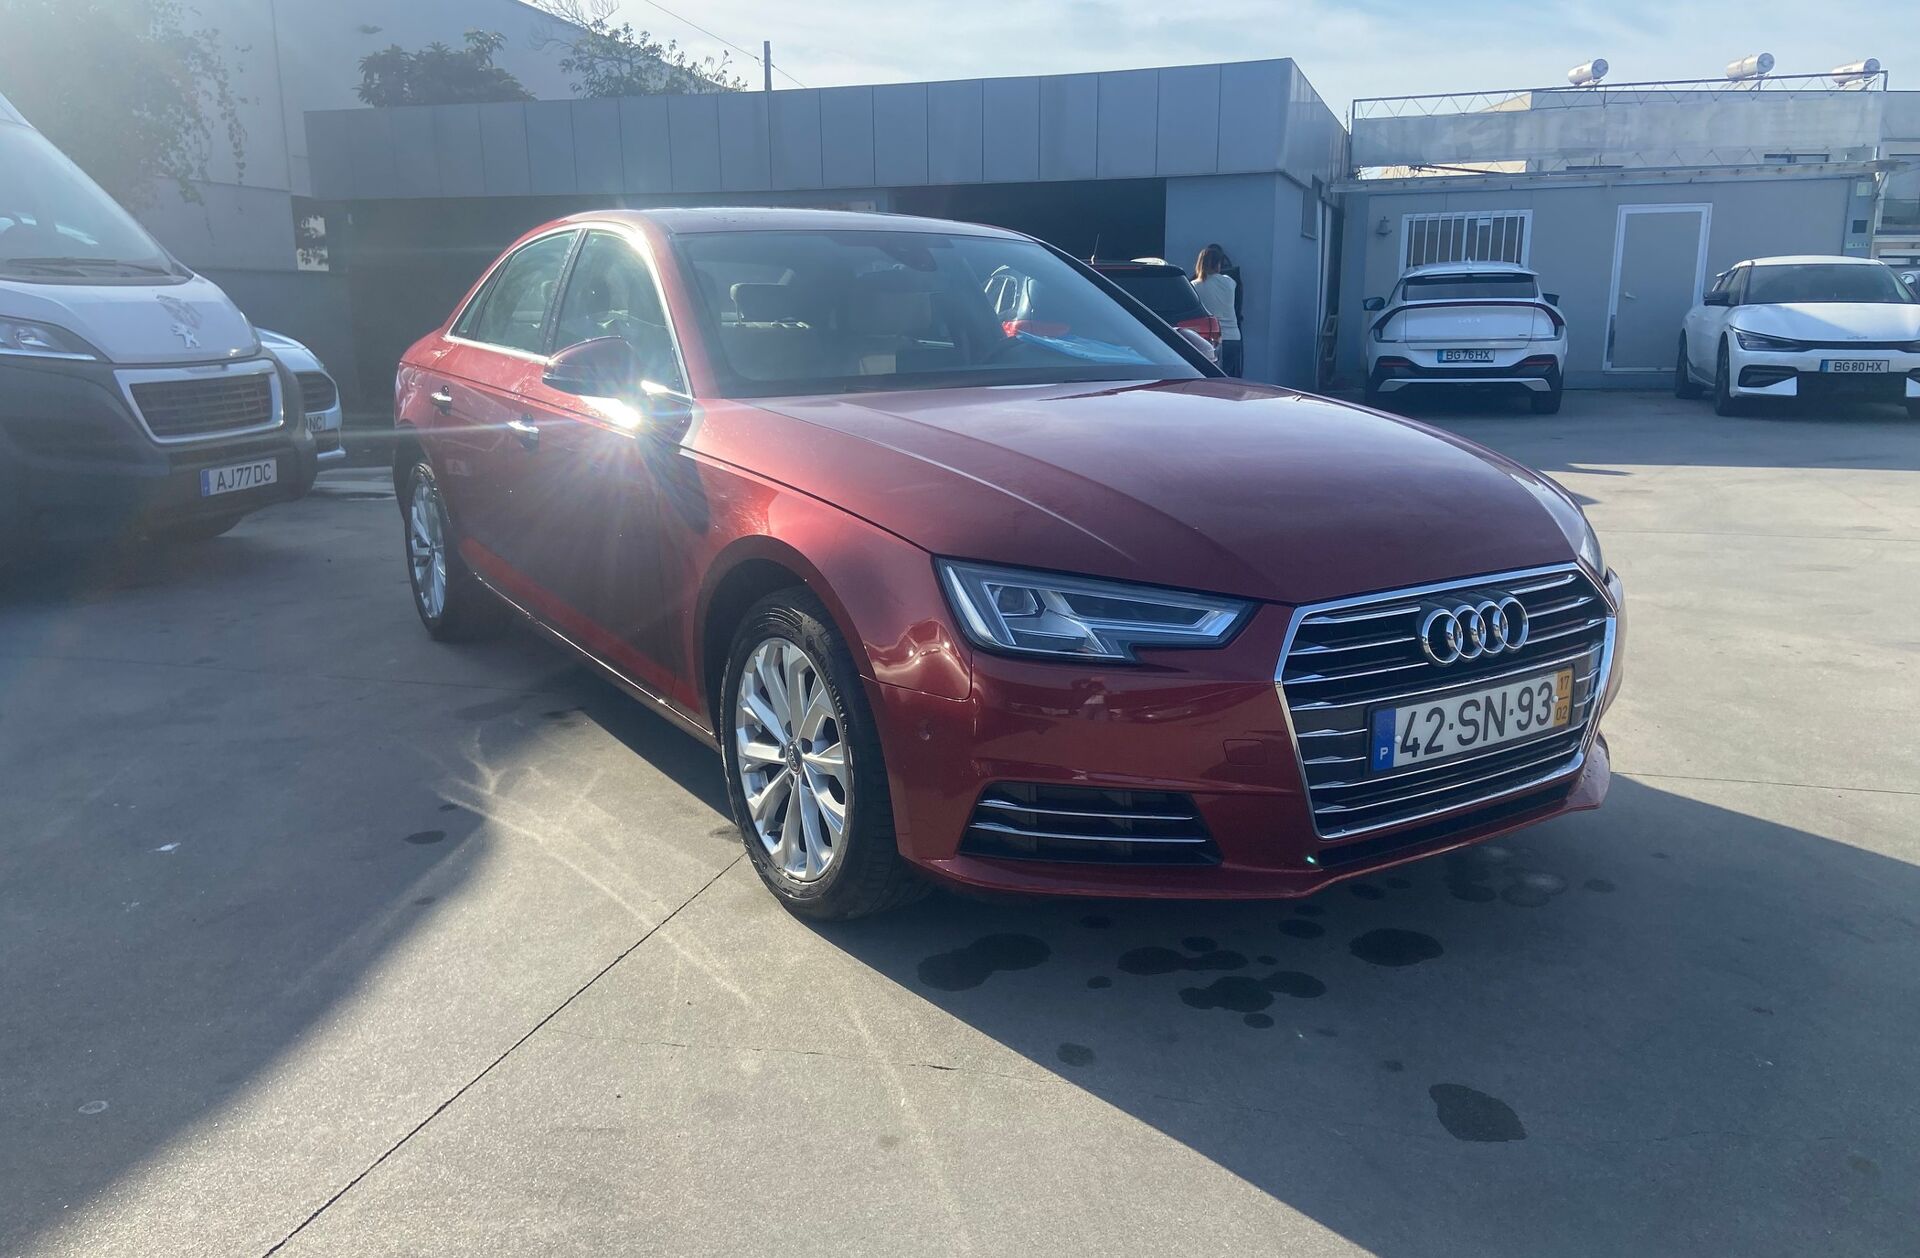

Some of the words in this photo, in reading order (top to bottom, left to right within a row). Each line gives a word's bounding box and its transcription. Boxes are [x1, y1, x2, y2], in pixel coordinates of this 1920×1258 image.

[1559, 675, 1570, 690] 17
[1555, 705, 1568, 721] 02
[1379, 747, 1389, 760] P
